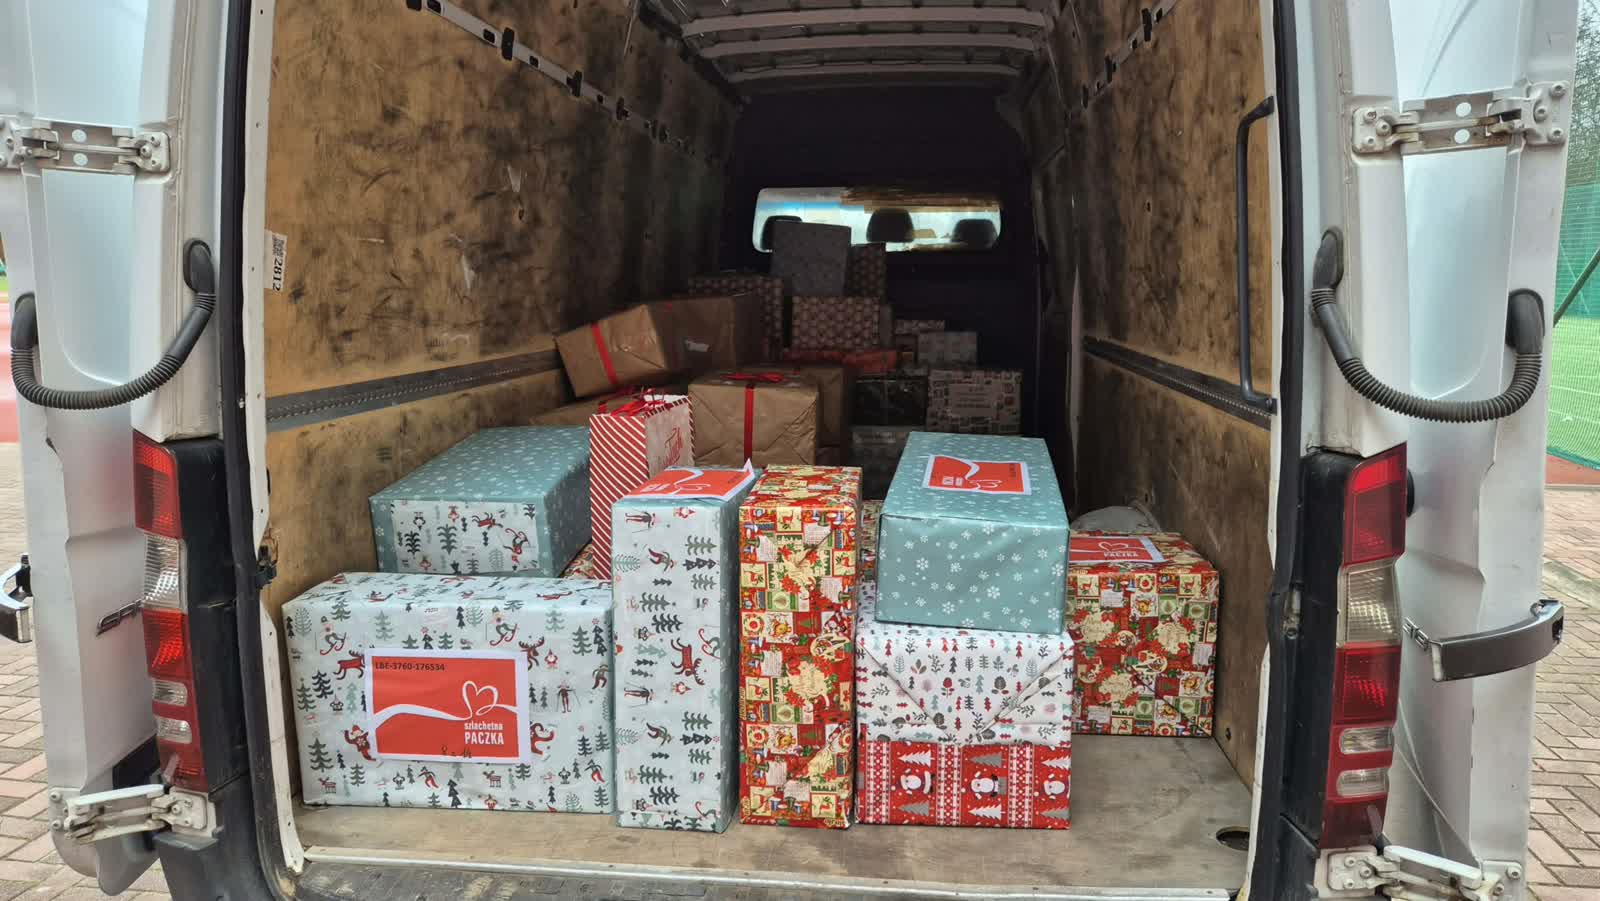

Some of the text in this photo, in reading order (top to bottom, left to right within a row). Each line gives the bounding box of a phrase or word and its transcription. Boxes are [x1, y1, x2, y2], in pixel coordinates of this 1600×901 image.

[272, 257, 283, 291] 2812
[464, 720, 503, 731] szlachetna
[464, 731, 504, 745] PACZKA
